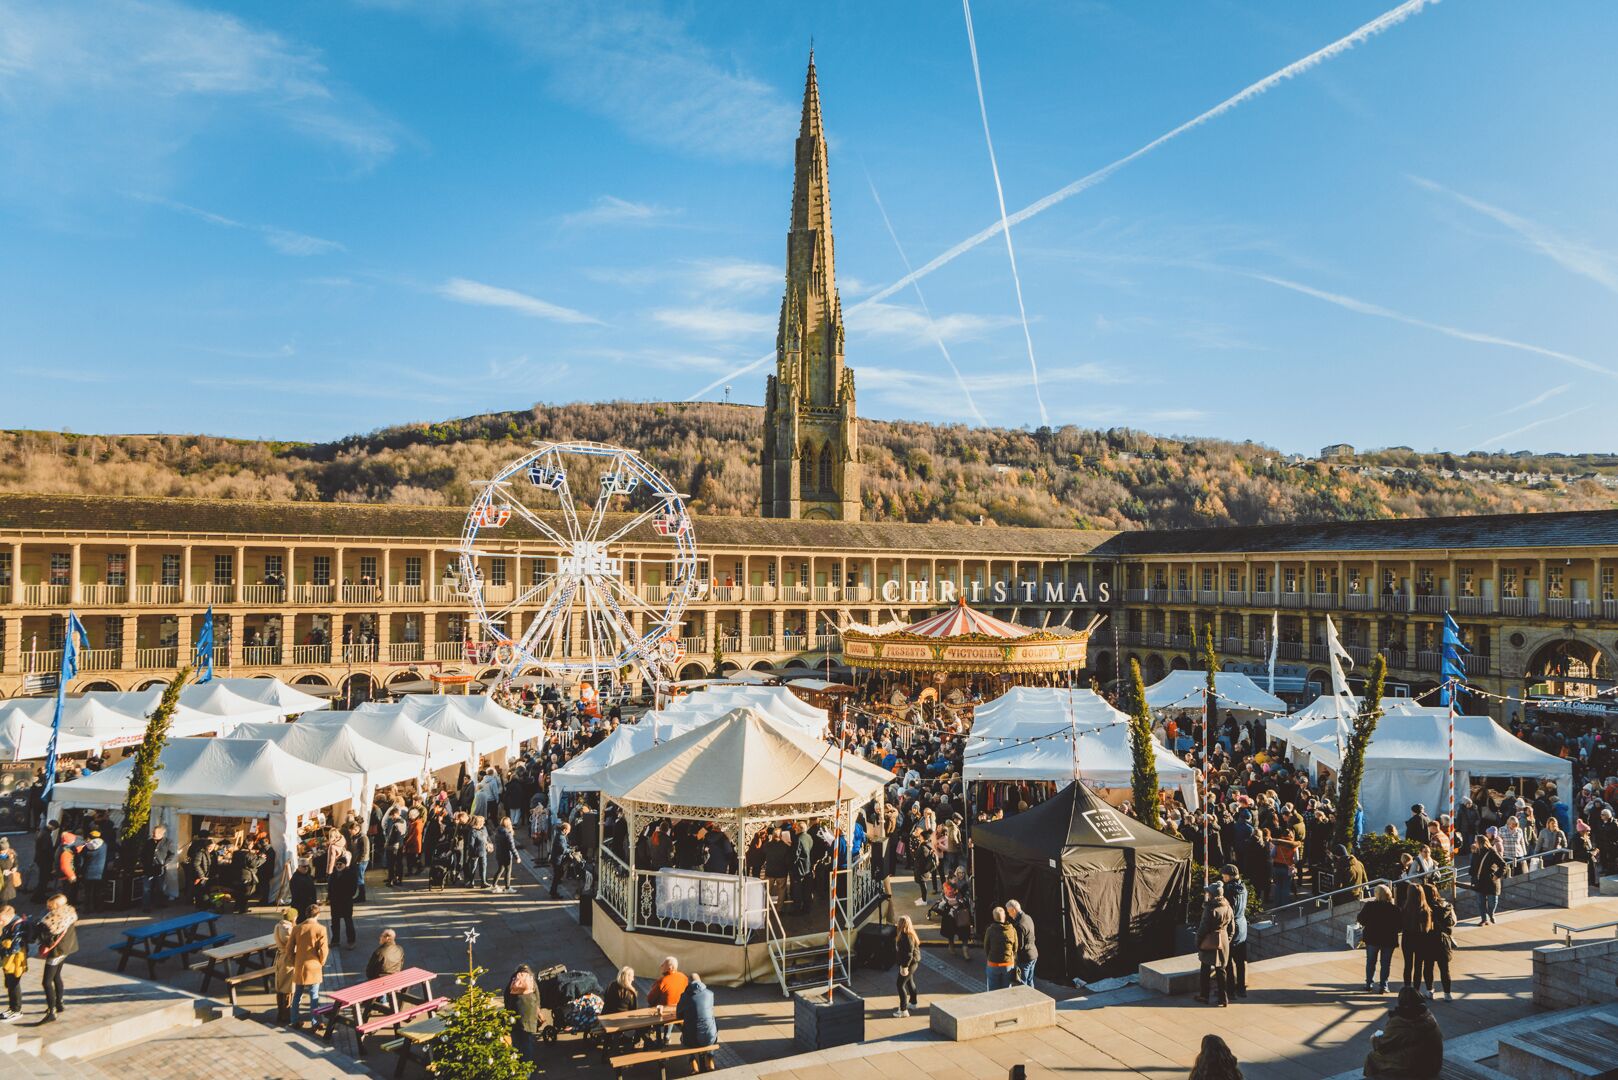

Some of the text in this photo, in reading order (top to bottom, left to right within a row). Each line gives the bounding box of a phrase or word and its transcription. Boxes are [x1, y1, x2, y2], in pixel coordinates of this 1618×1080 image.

[574, 541, 607, 558] BIG
[558, 557, 622, 575] WHEEL
[882, 580, 1110, 602] CHRISTMAS
[886, 646, 926, 657] PRESENTS
[951, 648, 998, 658] VICTORIAN
[1573, 702, 1607, 711] Chocolate
